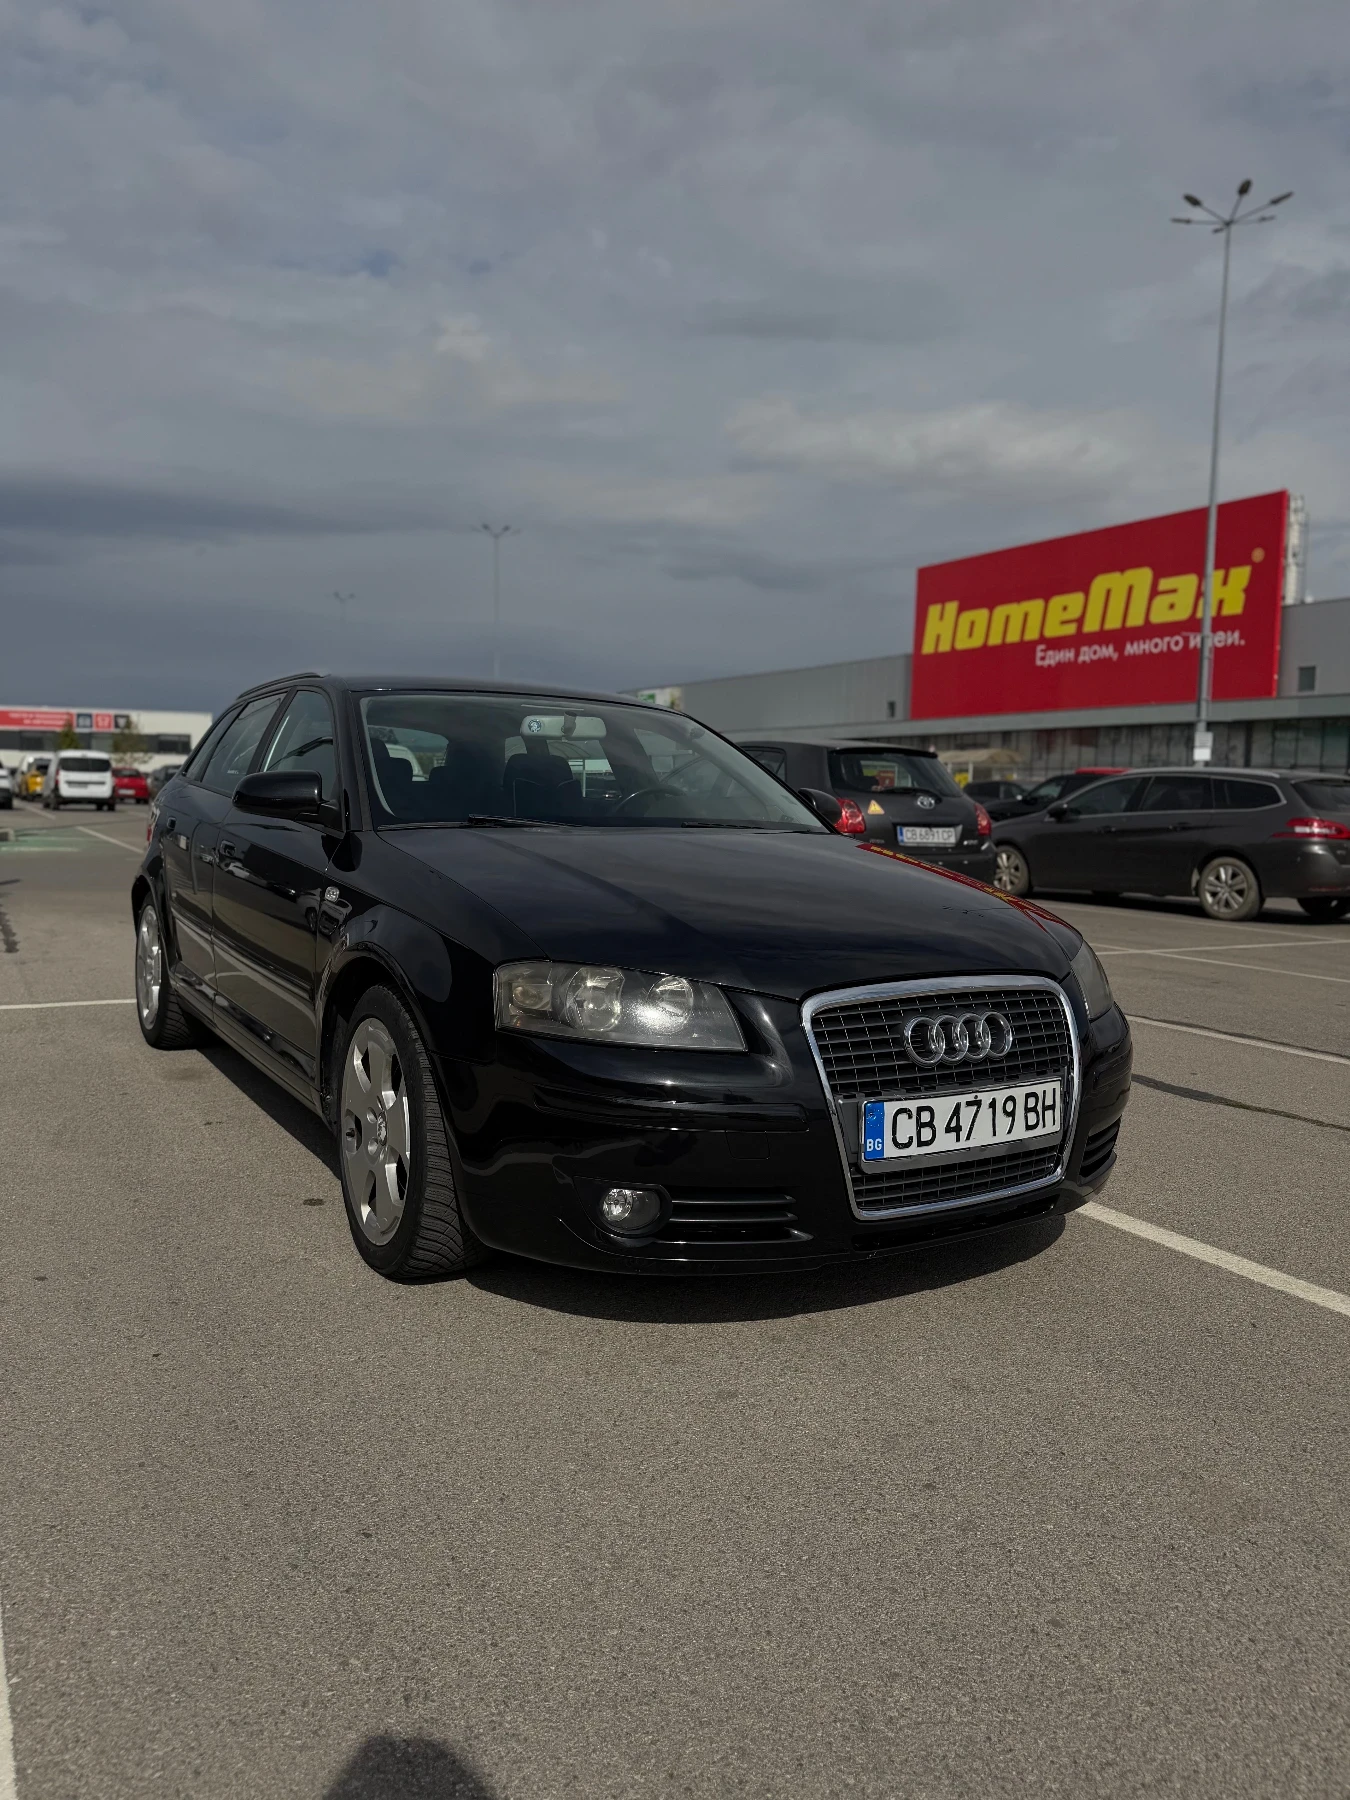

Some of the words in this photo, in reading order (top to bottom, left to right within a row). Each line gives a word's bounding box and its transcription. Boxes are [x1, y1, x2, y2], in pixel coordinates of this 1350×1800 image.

[921, 565, 1252, 655] HomeMax
[1035, 643, 1076, 668] Един
[1077, 642, 1119, 662] дом,
[1124, 634, 1184, 657] много
[1188, 629, 1246, 650] иеи.
[891, 1105, 937, 1150] CB
[944, 1095, 1017, 1142] 4719
[1023, 1086, 1057, 1132] BH
[866, 1137, 882, 1152] BG
